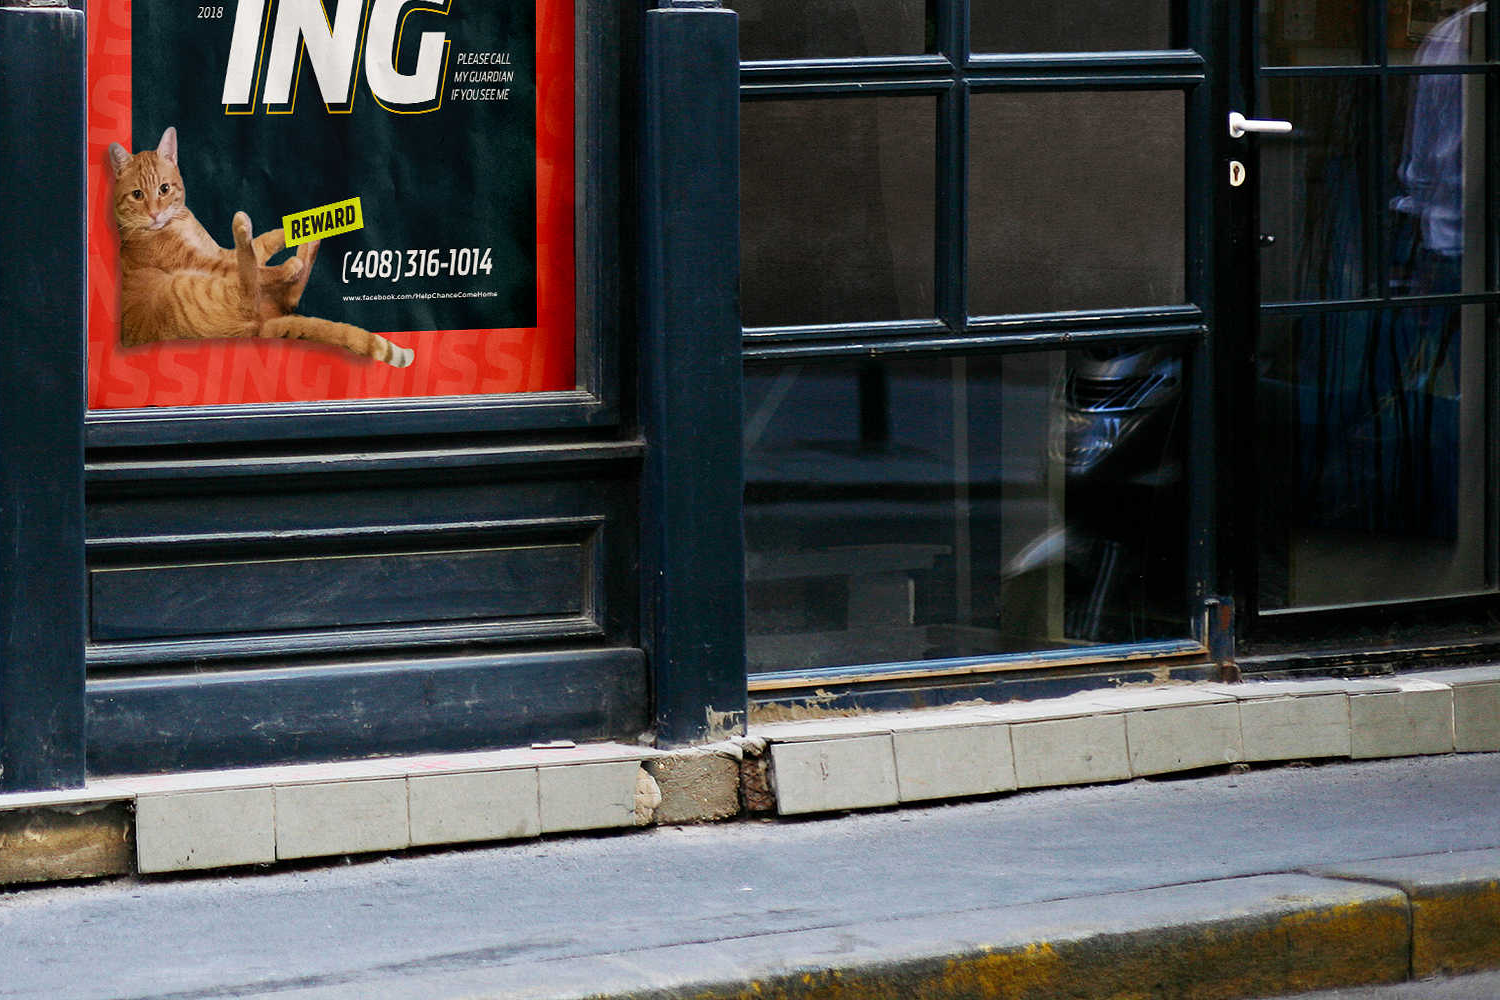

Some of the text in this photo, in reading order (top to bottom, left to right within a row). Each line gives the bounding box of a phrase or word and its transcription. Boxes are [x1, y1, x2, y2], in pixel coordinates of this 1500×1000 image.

[197, 6, 224, 19] 2018
[457, 52, 511, 65] PLEASE CALL
[453, 70, 514, 83] MY GUARDIAN
[450, 88, 511, 101] IF YOU SEE ME
[291, 205, 356, 240] REWARD
[342, 247, 493, 284] (408) 316-1014
[342, 290, 498, 302] www.facebook.com/HelpChanceComeHome
